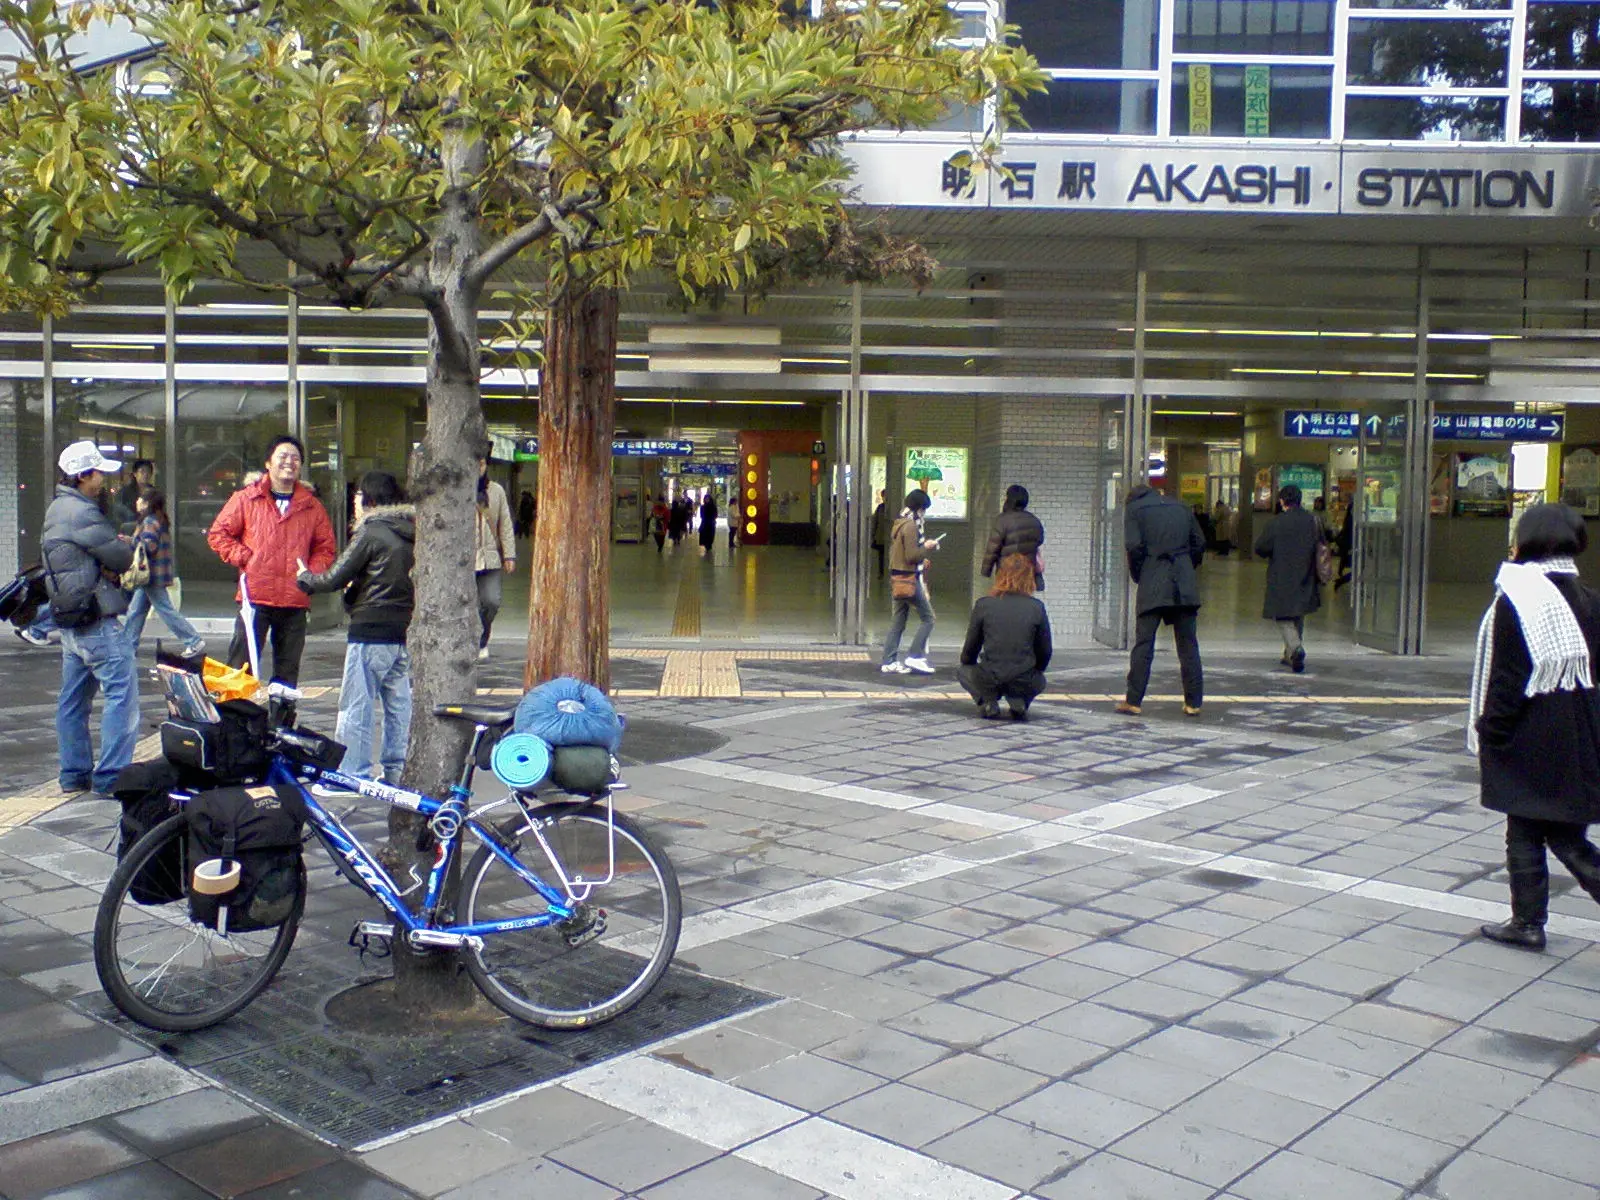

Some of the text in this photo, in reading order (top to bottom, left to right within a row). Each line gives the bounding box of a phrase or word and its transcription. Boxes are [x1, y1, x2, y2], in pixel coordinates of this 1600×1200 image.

[942, 160, 1097, 201] 明石駅
[1127, 163, 1555, 208] AKASHI STATION
